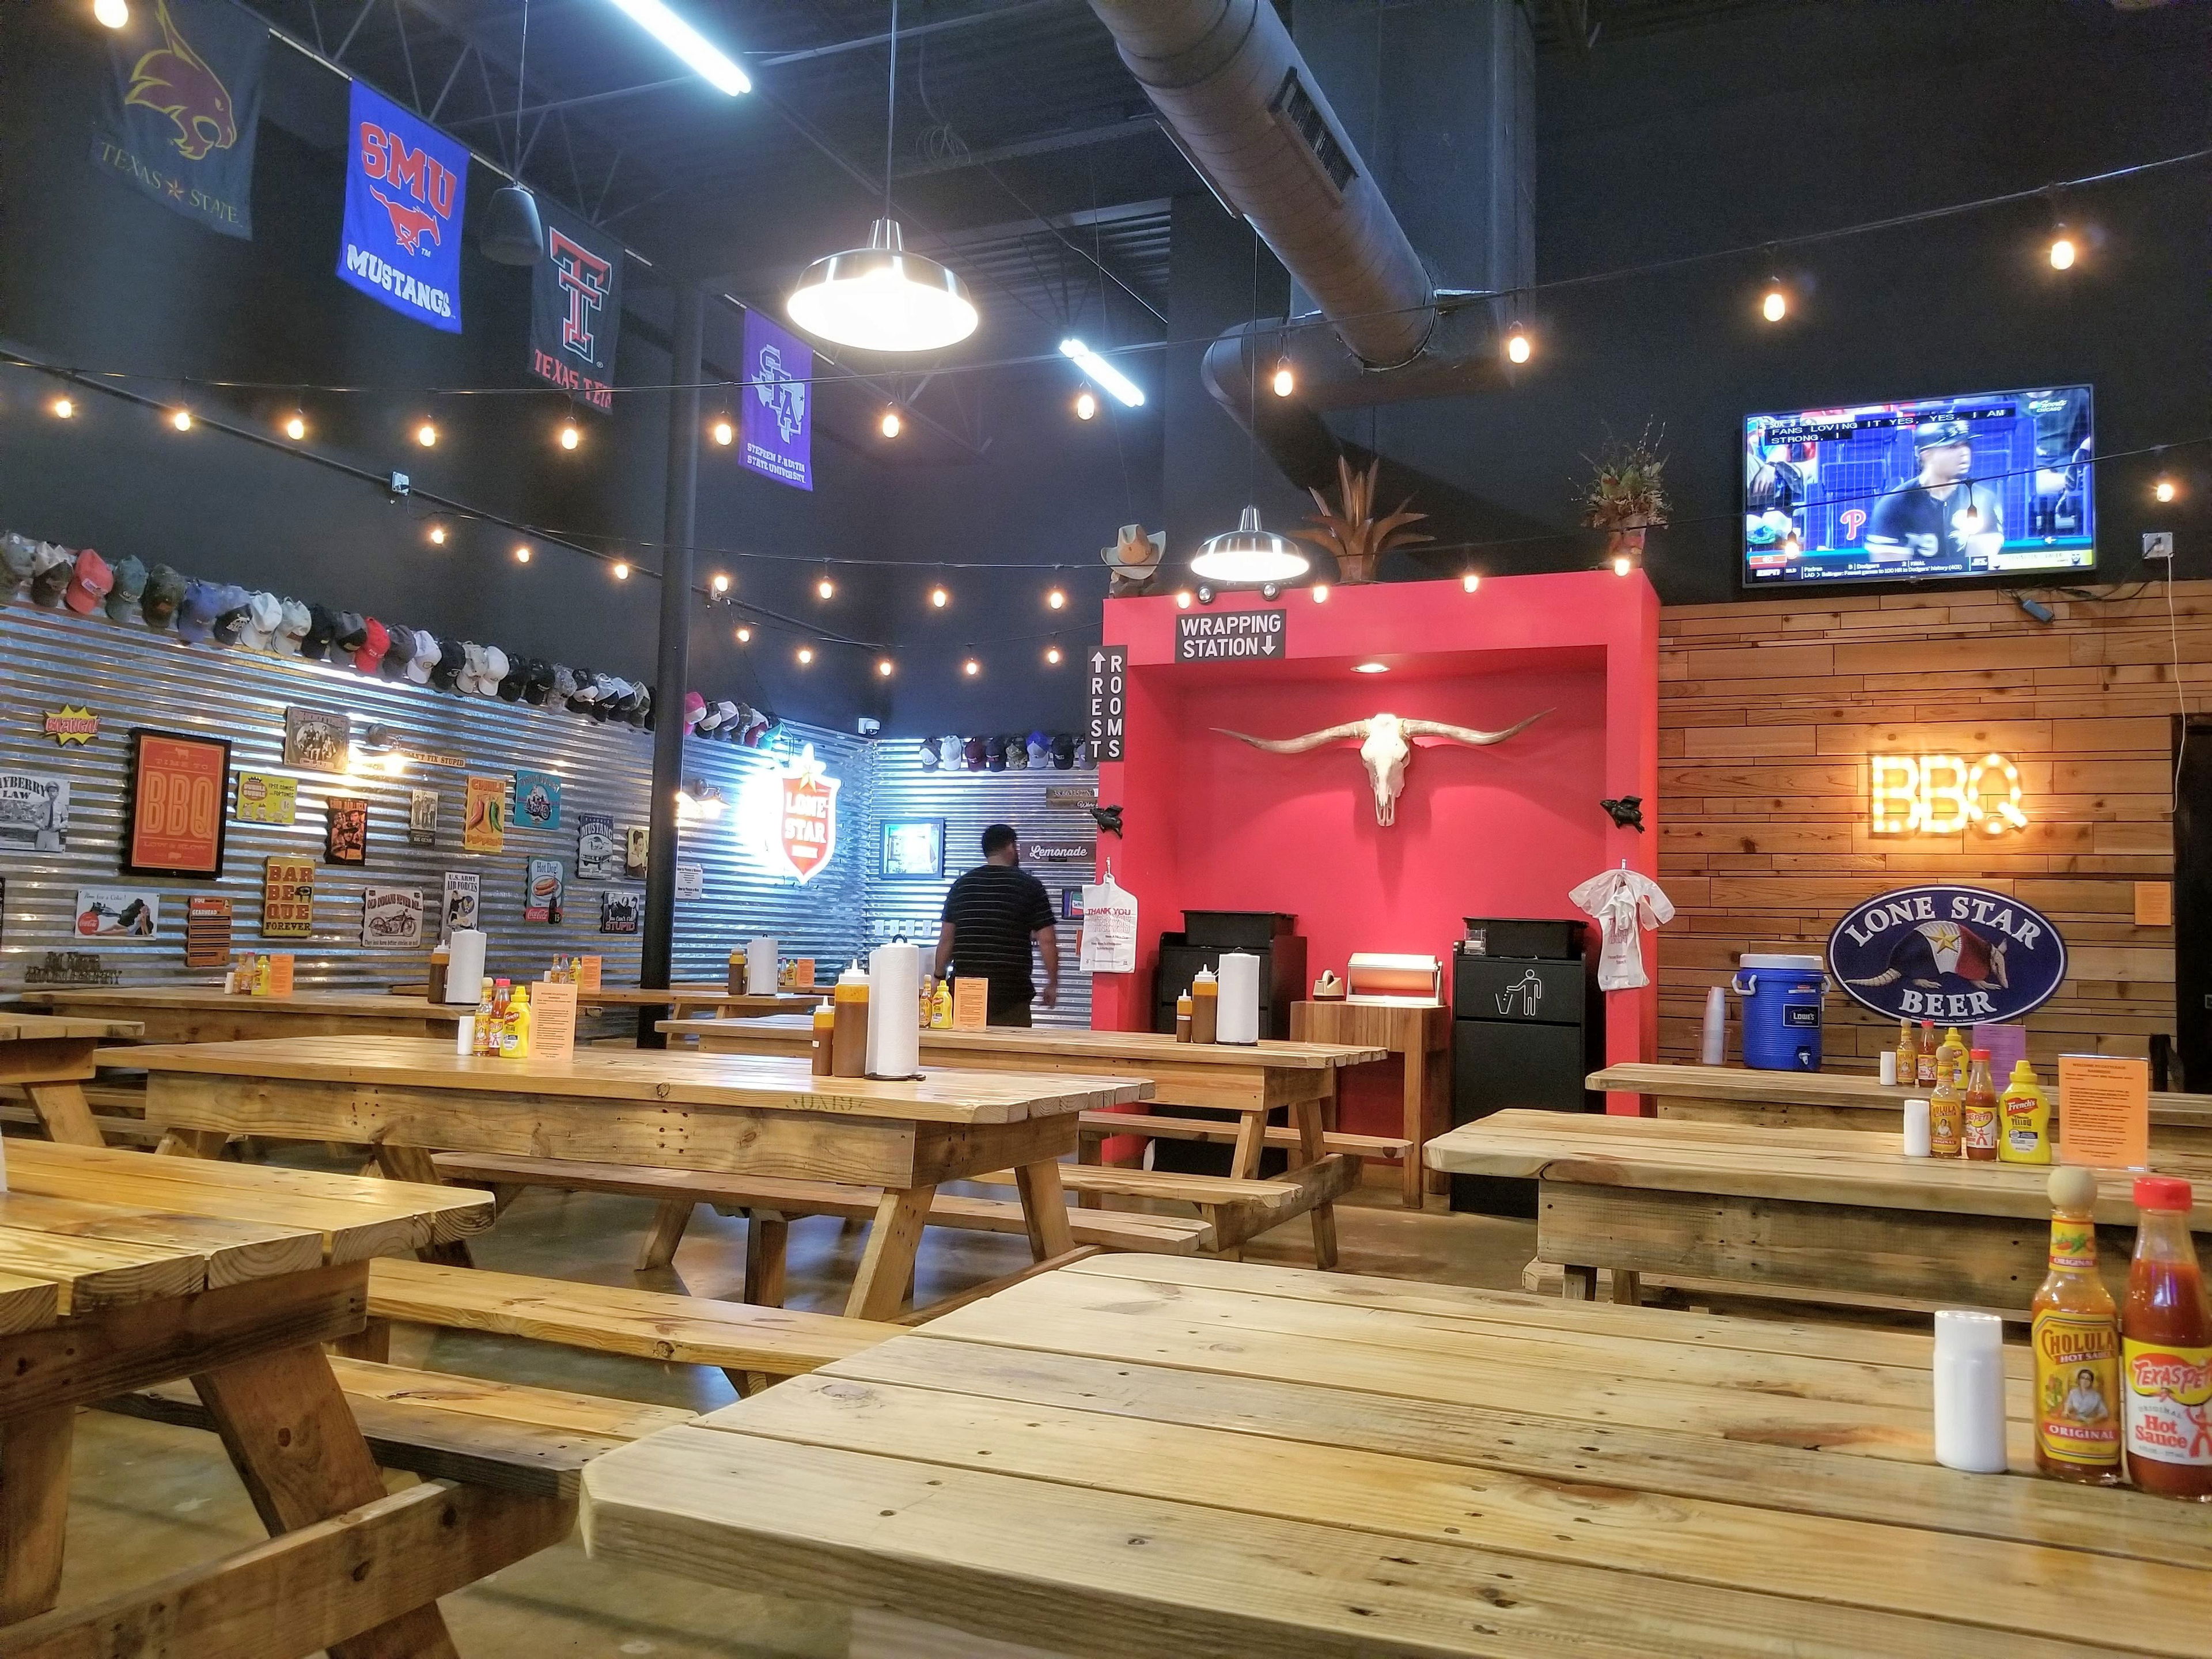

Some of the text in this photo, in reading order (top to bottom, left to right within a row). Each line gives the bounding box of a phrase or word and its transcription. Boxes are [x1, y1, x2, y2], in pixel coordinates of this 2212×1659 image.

[360, 121, 457, 219] SMU
[100, 142, 238, 224] TEXAS STATE
[347, 244, 451, 318] MUSTANGS
[535, 349, 579, 390] TEXAS
[1772, 427, 1803, 435] FANS
[1810, 423, 1858, 432] LOVING
[1930, 414, 1960, 422] YES.
[1987, 409, 2005, 418] AM
[1771, 434, 1823, 444] STRONG.
[747, 442, 776, 462] STEPHEN
[783, 457, 805, 472] AUSTIN
[747, 455, 805, 483] STATE UNIVERSITY
[1840, 509, 1866, 540] P
[1181, 614, 1282, 637] WRAPPING
[1183, 637, 1259, 658] STATION
[1107, 655, 1123, 758] ROOMS
[46, 718, 101, 734] BAZINGA!
[1091, 677, 1103, 759] REST
[154, 758, 188, 768] TIME
[441, 757, 464, 766] STUPID
[3, 790, 31, 799] LAW
[243, 790, 266, 798] BUBBLE
[1871, 752, 2028, 835] BBQ
[142, 771, 214, 839] BBQ
[786, 792, 830, 819] LONE
[581, 822, 613, 841] MUSTANG
[785, 817, 827, 844] STAR
[1029, 844, 1088, 859] Lemonade
[268, 865, 313, 882] BAR
[537, 862, 558, 874] Hot Dog!
[446, 881, 478, 893] AIR FORCES
[460, 874, 477, 882] ARMY
[267, 884, 294, 901] BE
[368, 898, 377, 909] OLD
[396, 893, 411, 908] NEVER
[267, 903, 310, 920] QUE
[1087, 907, 1112, 915] THANK
[265, 921, 310, 931] FOREVER
[605, 922, 635, 931] STUPID
[1844, 896, 2042, 951] LONE STAR
[1899, 988, 1998, 1018] BEER
[1793, 1012, 1815, 1021] LOWE'S
[2008, 1100, 2035, 1111] French's
[2012, 1118, 2032, 1127] YELLOW
[2054, 1257, 2094, 1267] ORIGINAL
[2041, 1329, 2115, 1363] CHOLULA
[2059, 1354, 2083, 1363] HOT
[2133, 1360, 2181, 1386] TEXAS
[2048, 1424, 2114, 1440] ORIGINAL
[2145, 1414, 2177, 1435] Hot
[2135, 1425, 2188, 1449] Sauce
